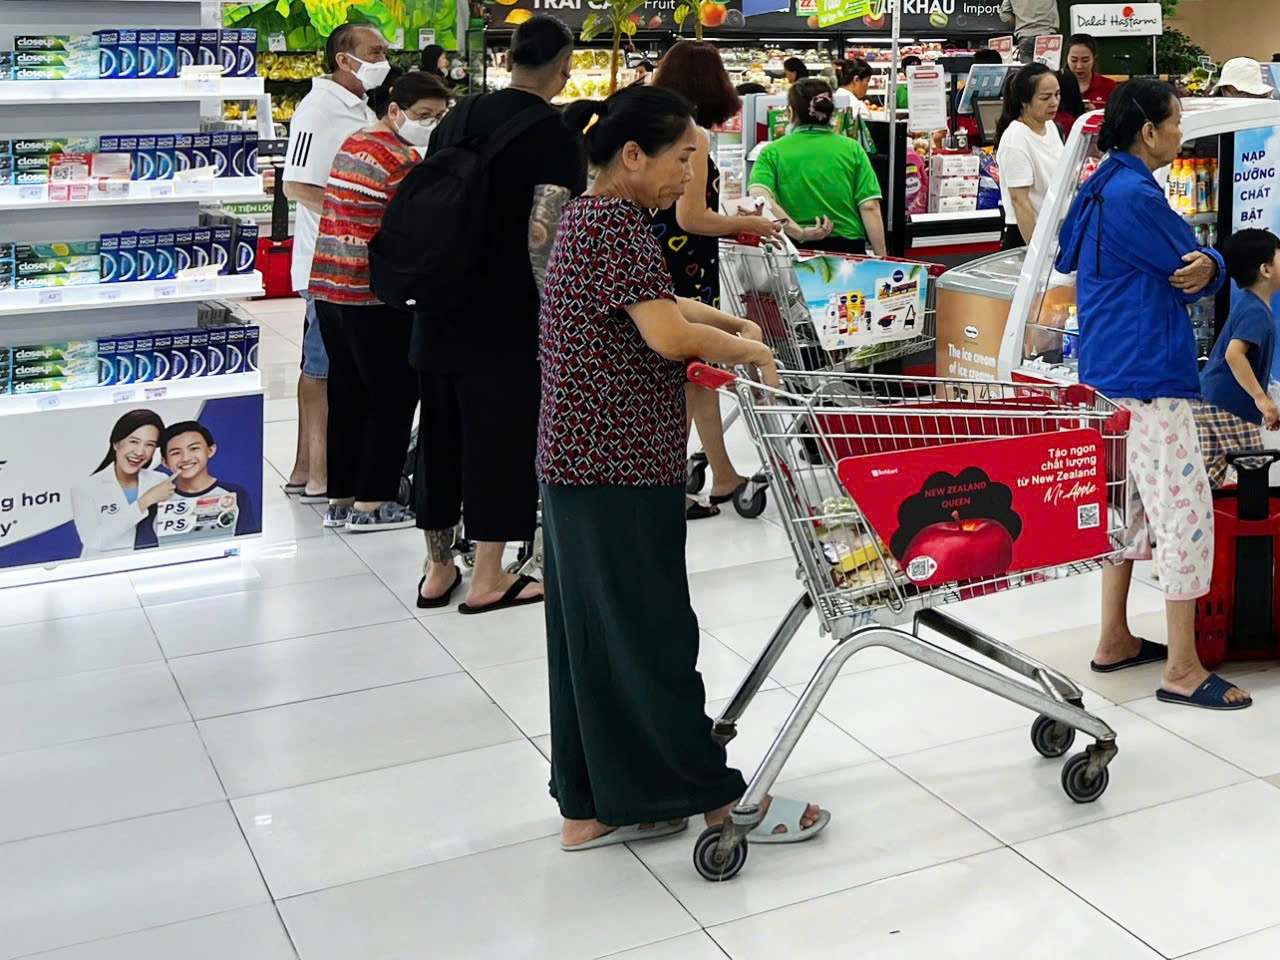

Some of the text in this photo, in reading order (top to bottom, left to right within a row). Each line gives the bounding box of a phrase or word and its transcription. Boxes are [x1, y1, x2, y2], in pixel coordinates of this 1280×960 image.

[1077, 14, 1107, 28] Dalat
[17, 37, 54, 48] closeup
[17, 53, 54, 64] closeup
[15, 140, 52, 151] closeup
[1242, 150, 1266, 165] NẠP
[1234, 166, 1275, 183] DƯỠNG
[1240, 183, 1271, 201] CHẤT
[1240, 207, 1264, 223] BẬT
[19, 261, 55, 271] closeup
[16, 348, 52, 359] closeup
[948, 343, 961, 359] The
[974, 352, 996, 367] cream
[16, 365, 52, 375] closeup
[1070, 444, 1096, 457] ngon
[1041, 456, 1096, 471] chất lượng
[1032, 474, 1054, 485] New
[1056, 467, 1096, 482] Zealand
[925, 481, 987, 498] NEW ZEALAND
[22, 491, 61, 507] hơn
[942, 497, 970, 508] QUEEN
[101, 503, 118, 513] PS
[164, 502, 187, 515] PS
[164, 519, 187, 531] PS
